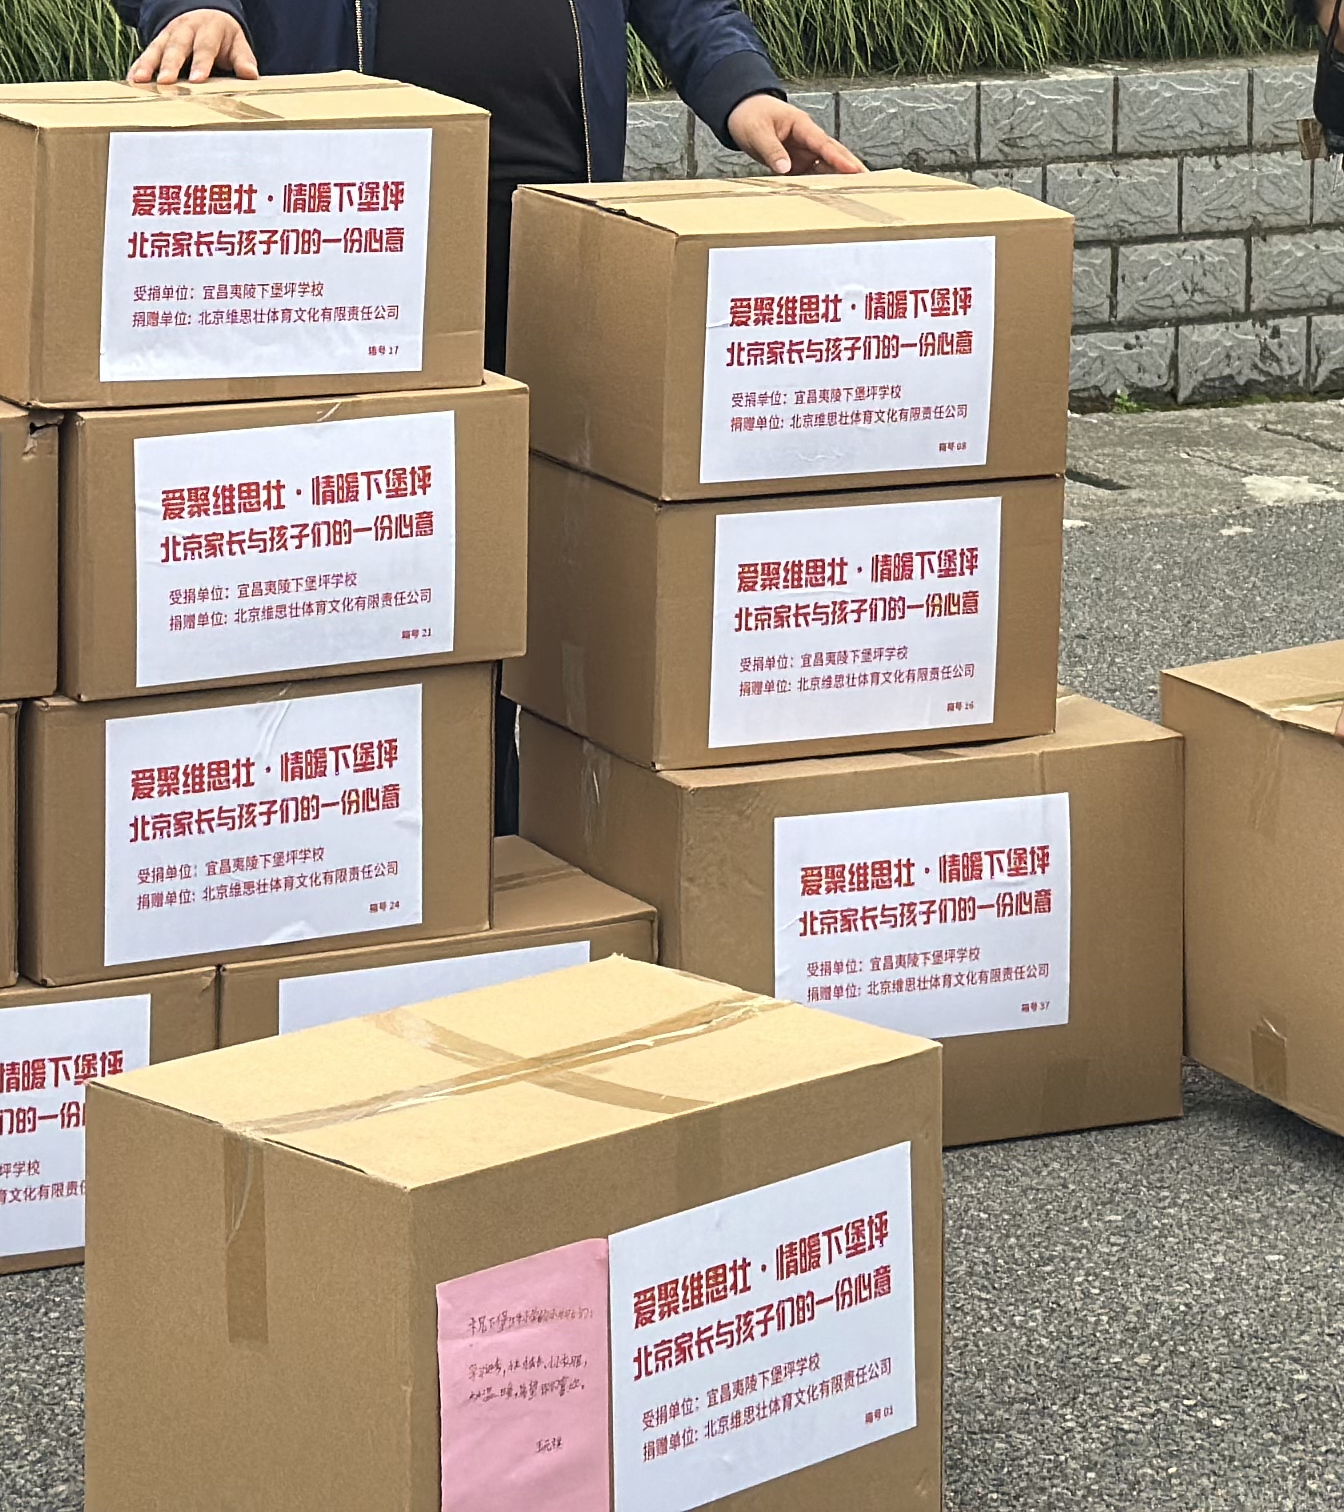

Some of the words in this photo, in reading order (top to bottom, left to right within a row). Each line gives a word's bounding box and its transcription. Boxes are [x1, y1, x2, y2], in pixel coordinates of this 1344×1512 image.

[131, 180, 405, 216] 爱聚维思壮·情暖下堡坪
[127, 227, 405, 258] 北京家长与孩子们的一份心意
[729, 287, 972, 327] 爱聚维思壮·情暖下堡坪
[389, 345, 399, 355] 17
[726, 331, 973, 367] 北京家长与孩子们的一份心意
[161, 465, 432, 520] 爱聚维思壮·情暖下堡坪
[160, 511, 434, 563] 北京家长与孩子们的一份心意
[737, 547, 978, 593] 爱聚维思壮·情暖下堡坪
[734, 590, 979, 632] 北京家长与孩子们的一份心意
[131, 738, 398, 800] 爱聚维思壮·情暖下堡坪
[129, 784, 400, 842] 北京家长与孩子们的一份心意
[800, 845, 1050, 897] 爱聚维思壮·情暖下堡坪
[799, 889, 1052, 937] 北京家长与孩子们的一份心意
[633, 1211, 888, 1330] 爱聚维思壮·情暖下堡坪
[633, 1265, 892, 1381] 北京家长与孩子们的一份心意
